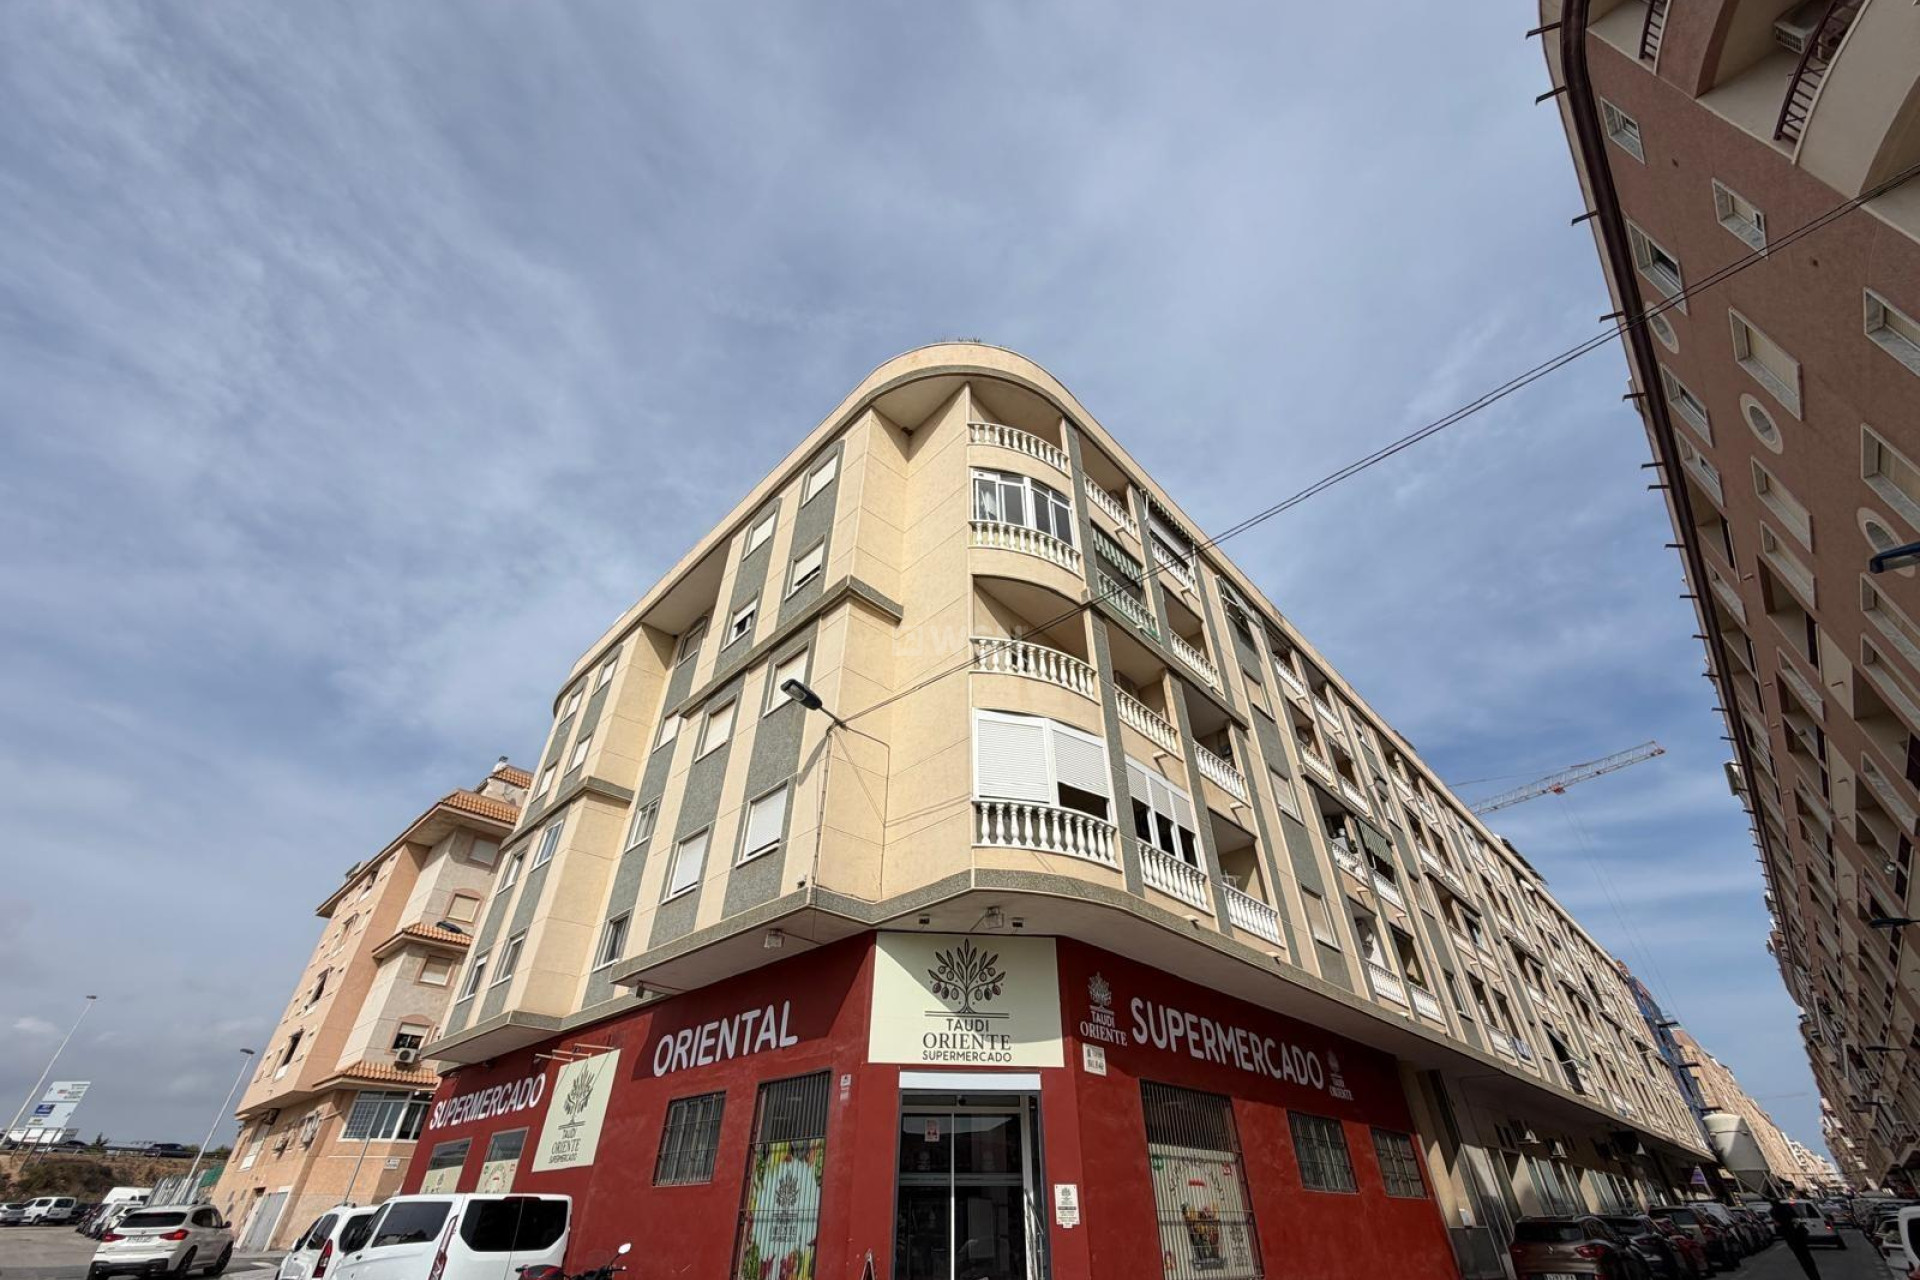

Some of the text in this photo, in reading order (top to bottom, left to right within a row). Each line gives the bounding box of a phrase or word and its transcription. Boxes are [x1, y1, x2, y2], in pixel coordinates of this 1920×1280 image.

[946, 1018, 989, 1032] TAUDI
[1090, 1010, 1115, 1028] TAUDI
[653, 1000, 798, 1077] ORIENTAL
[923, 1032, 1011, 1050] ORIENTE
[1080, 1020, 1128, 1047] ORIENTE
[1131, 997, 1324, 1090] SUPERMERCADO
[922, 1050, 1012, 1062] SUPERMERCADO
[429, 1072, 546, 1130] SUPERMERCADO
